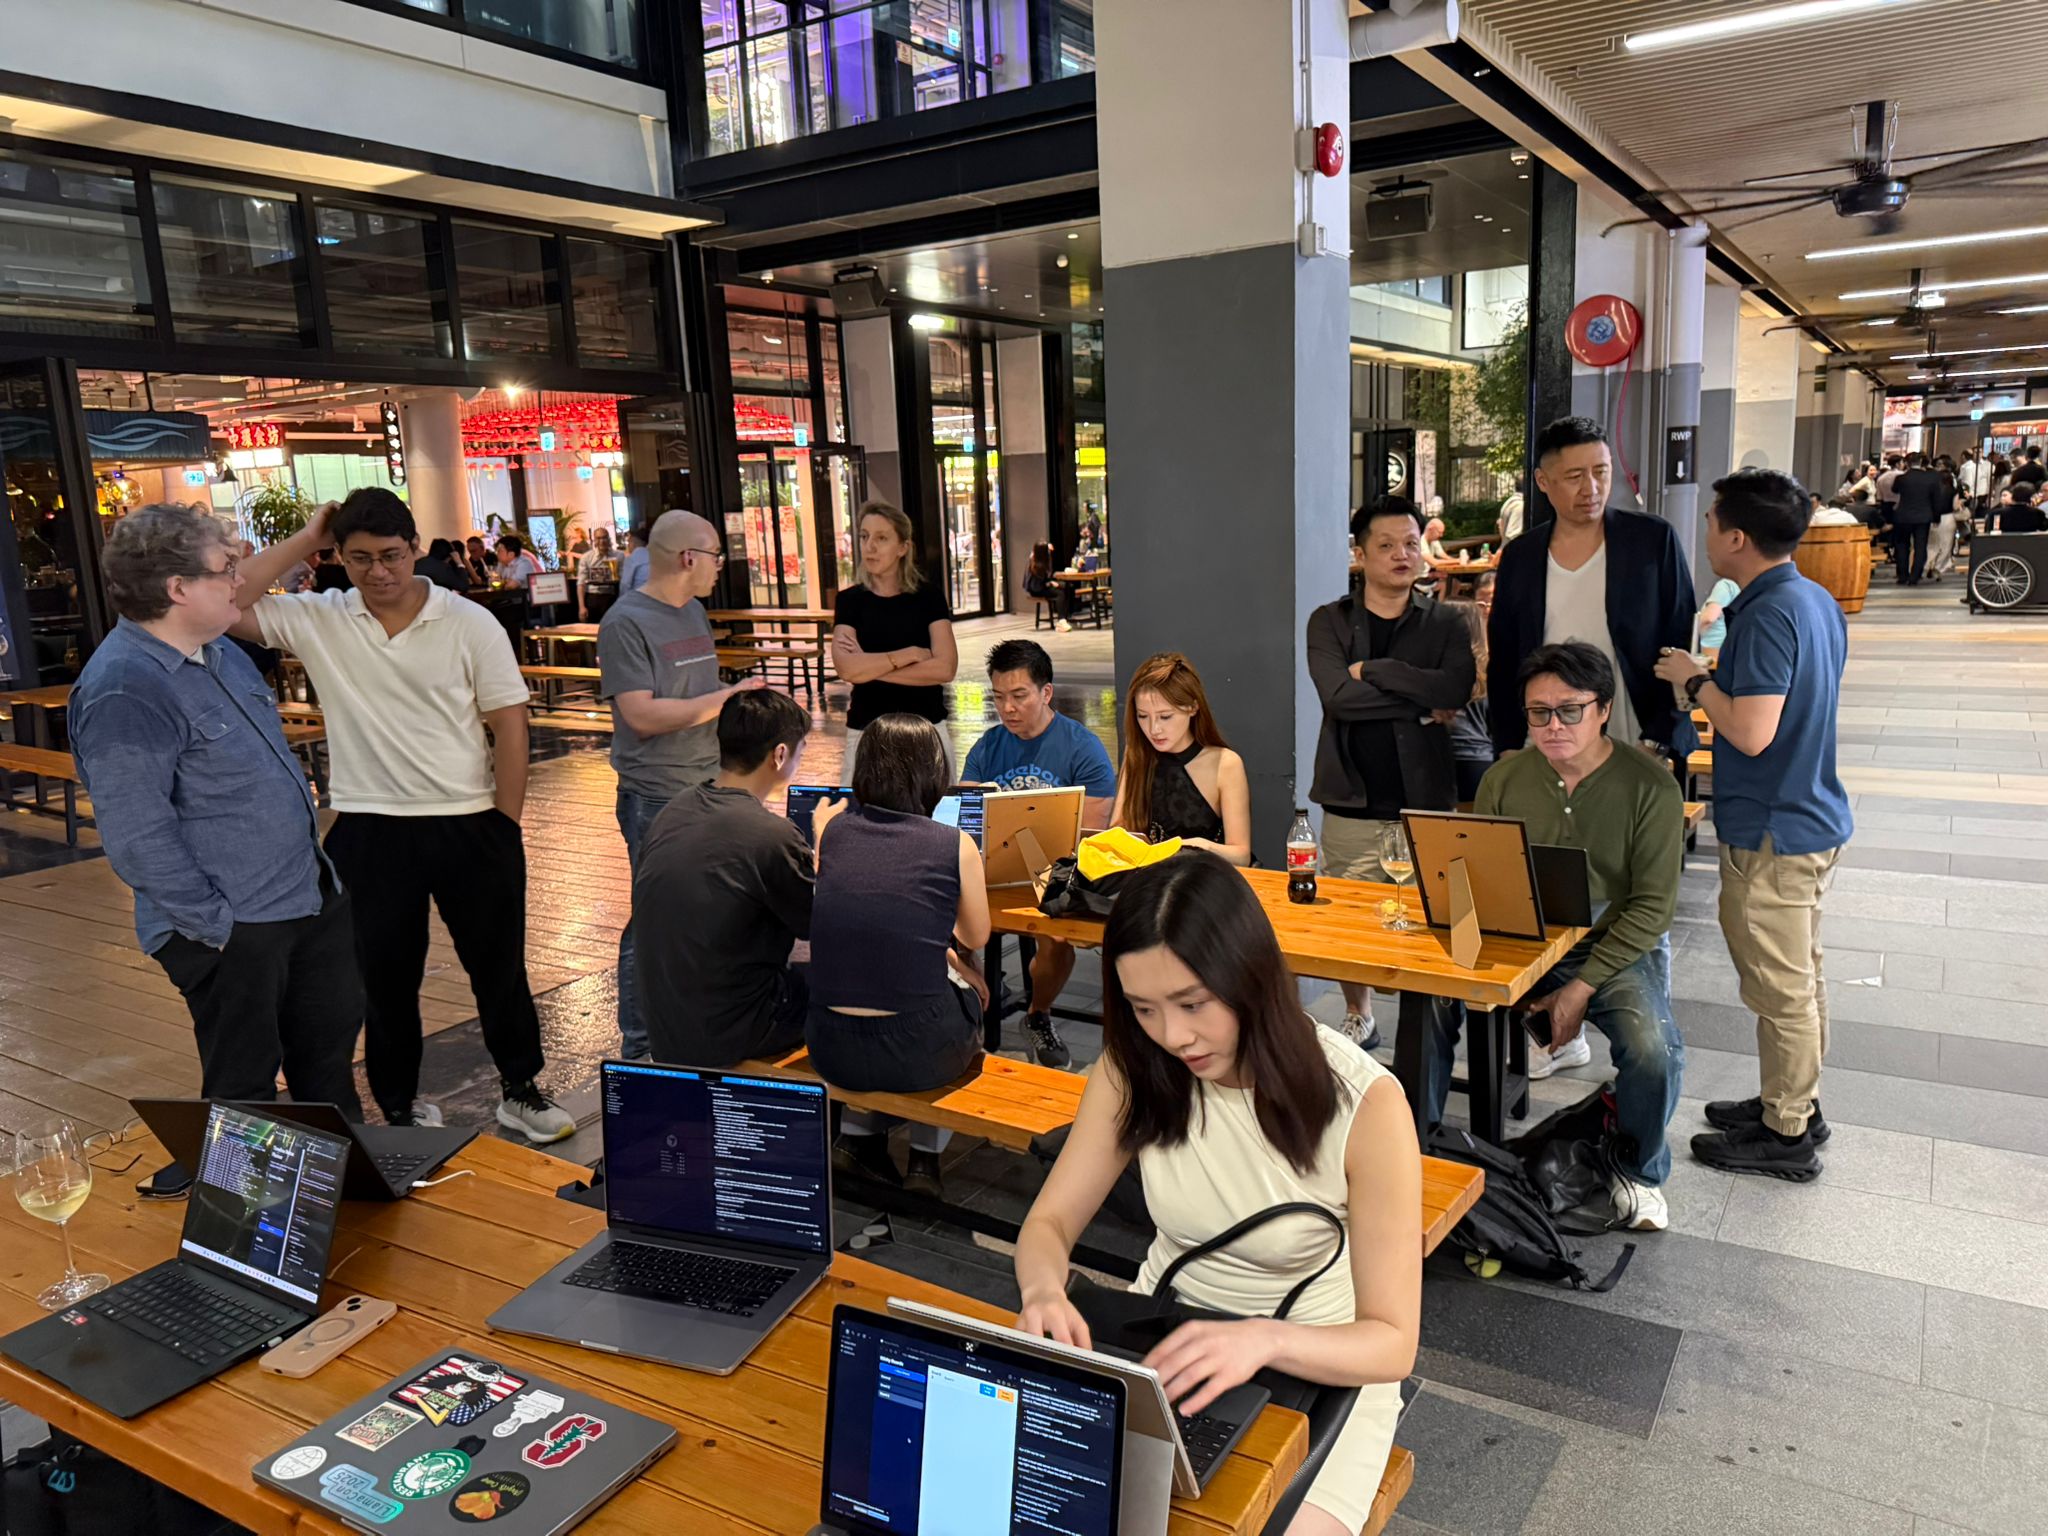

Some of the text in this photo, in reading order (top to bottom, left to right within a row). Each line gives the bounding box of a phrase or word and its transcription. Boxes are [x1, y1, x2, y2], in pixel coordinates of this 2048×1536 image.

[1671, 431, 1692, 441] RWP
[334, 1472, 365, 1489] 2025
[393, 1453, 430, 1496] RESTAURANT
[423, 1469, 465, 1495] ALICE'S
[337, 1484, 394, 1516] LlamaCon
